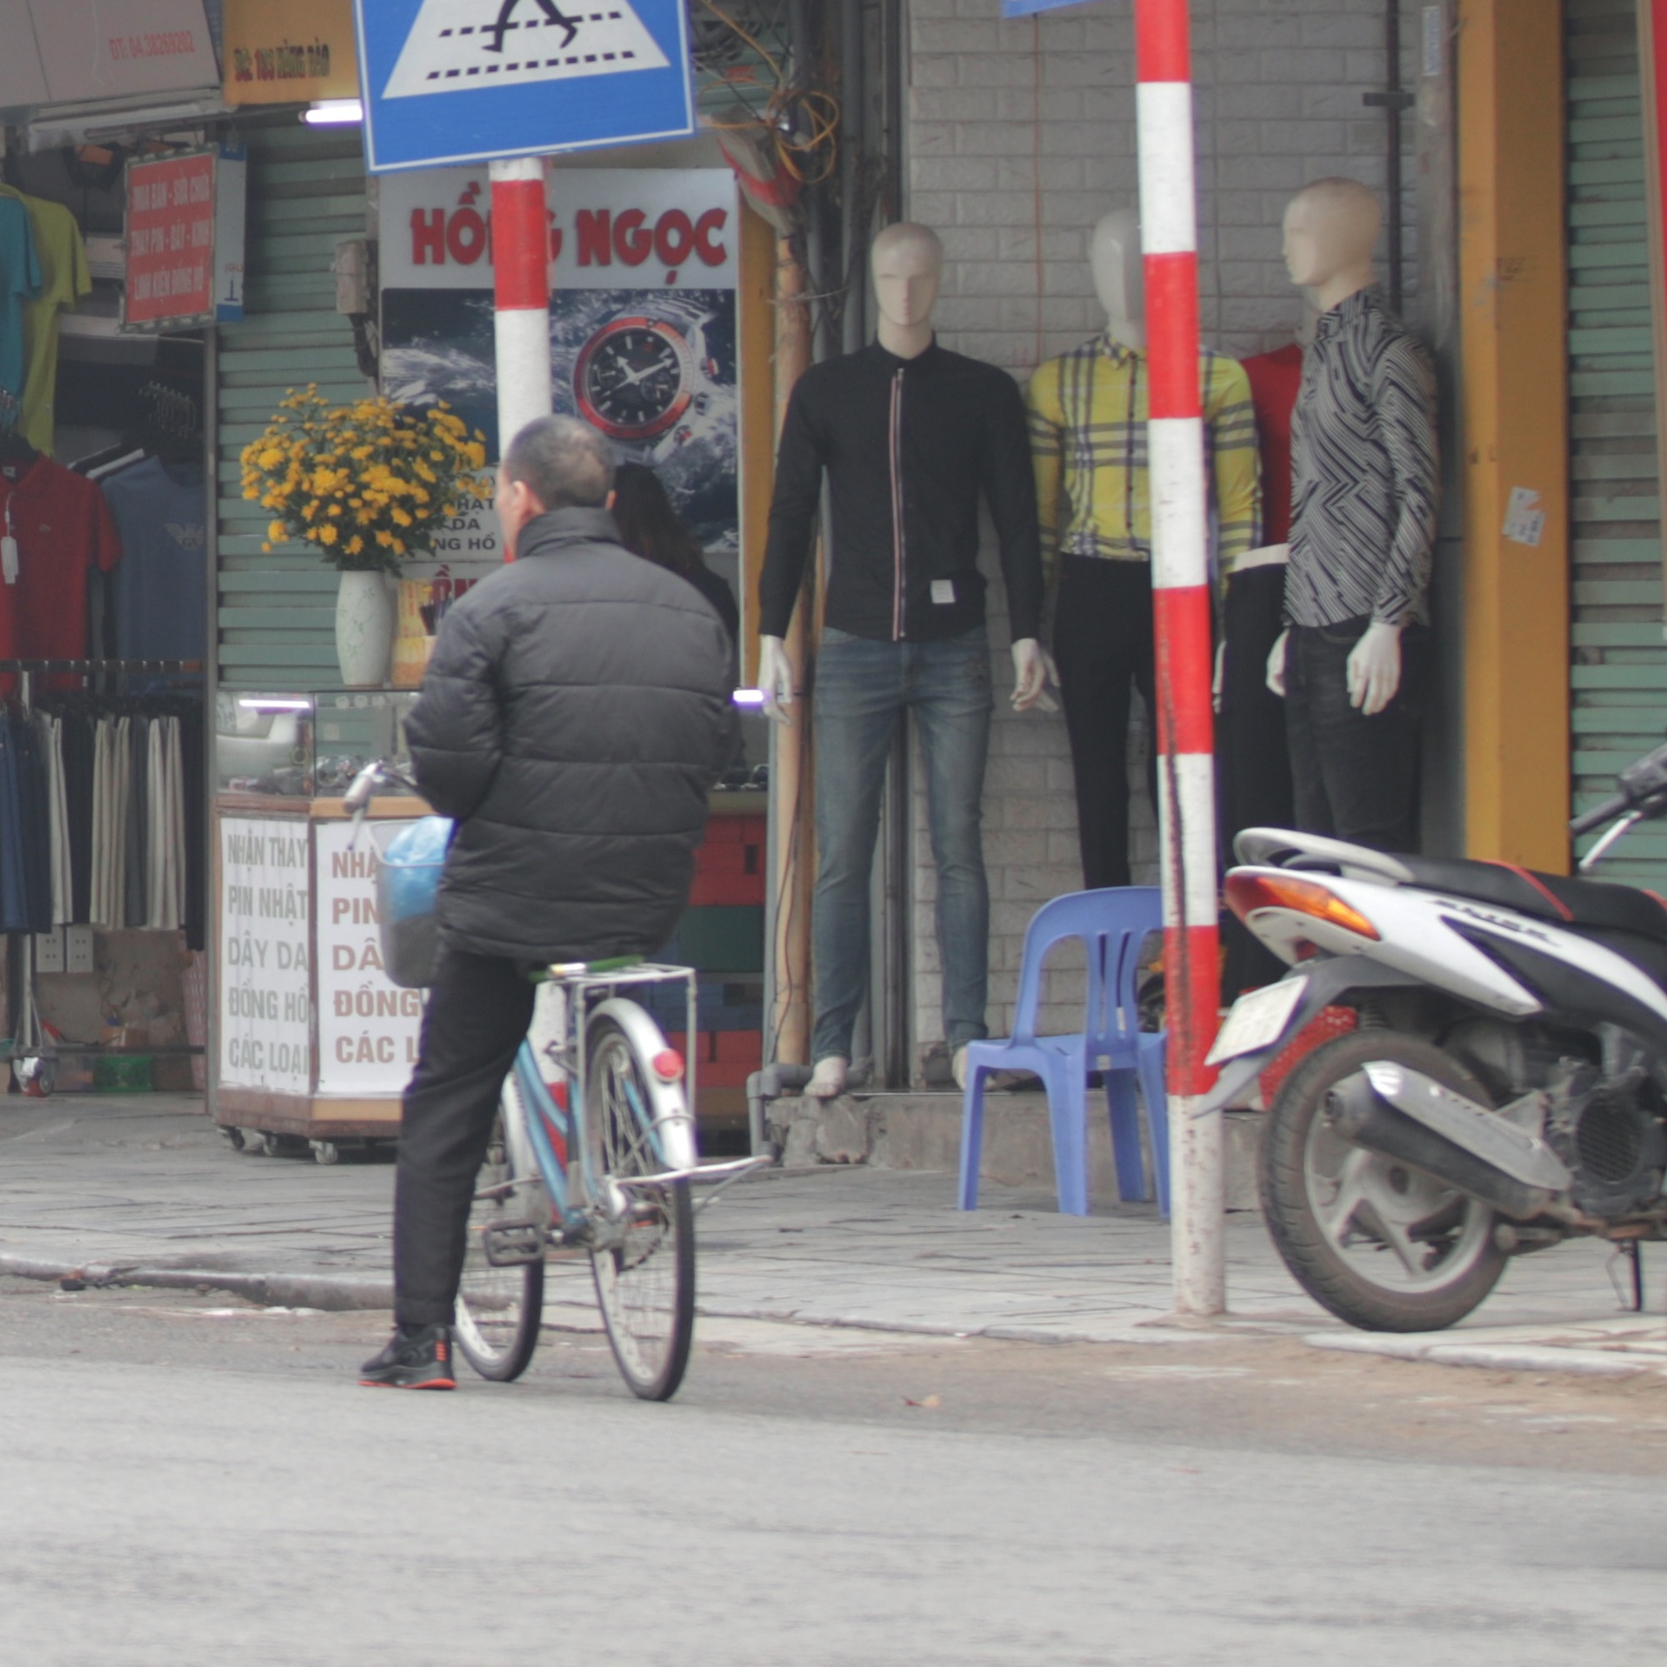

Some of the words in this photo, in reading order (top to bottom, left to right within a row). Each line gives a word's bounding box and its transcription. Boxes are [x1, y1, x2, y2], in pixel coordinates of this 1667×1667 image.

[576, 207, 728, 285] NGỌC
[468, 531, 497, 552] HỒ
[227, 830, 264, 873] NHẬN
[269, 837, 308, 868] THAY
[228, 885, 253, 917] PIN
[259, 882, 308, 927] NHẬT
[228, 929, 268, 968] DÂY
[277, 940, 309, 972] DA
[332, 936, 385, 971] DÂ
[228, 977, 278, 1020] ĐỒNG
[284, 982, 308, 1024] HỒ
[333, 979, 420, 1018] ĐỒNG
[229, 1033, 264, 1072] CÁC
[270, 1041, 308, 1082] LOẠI
[335, 1029, 395, 1064] CÁC
